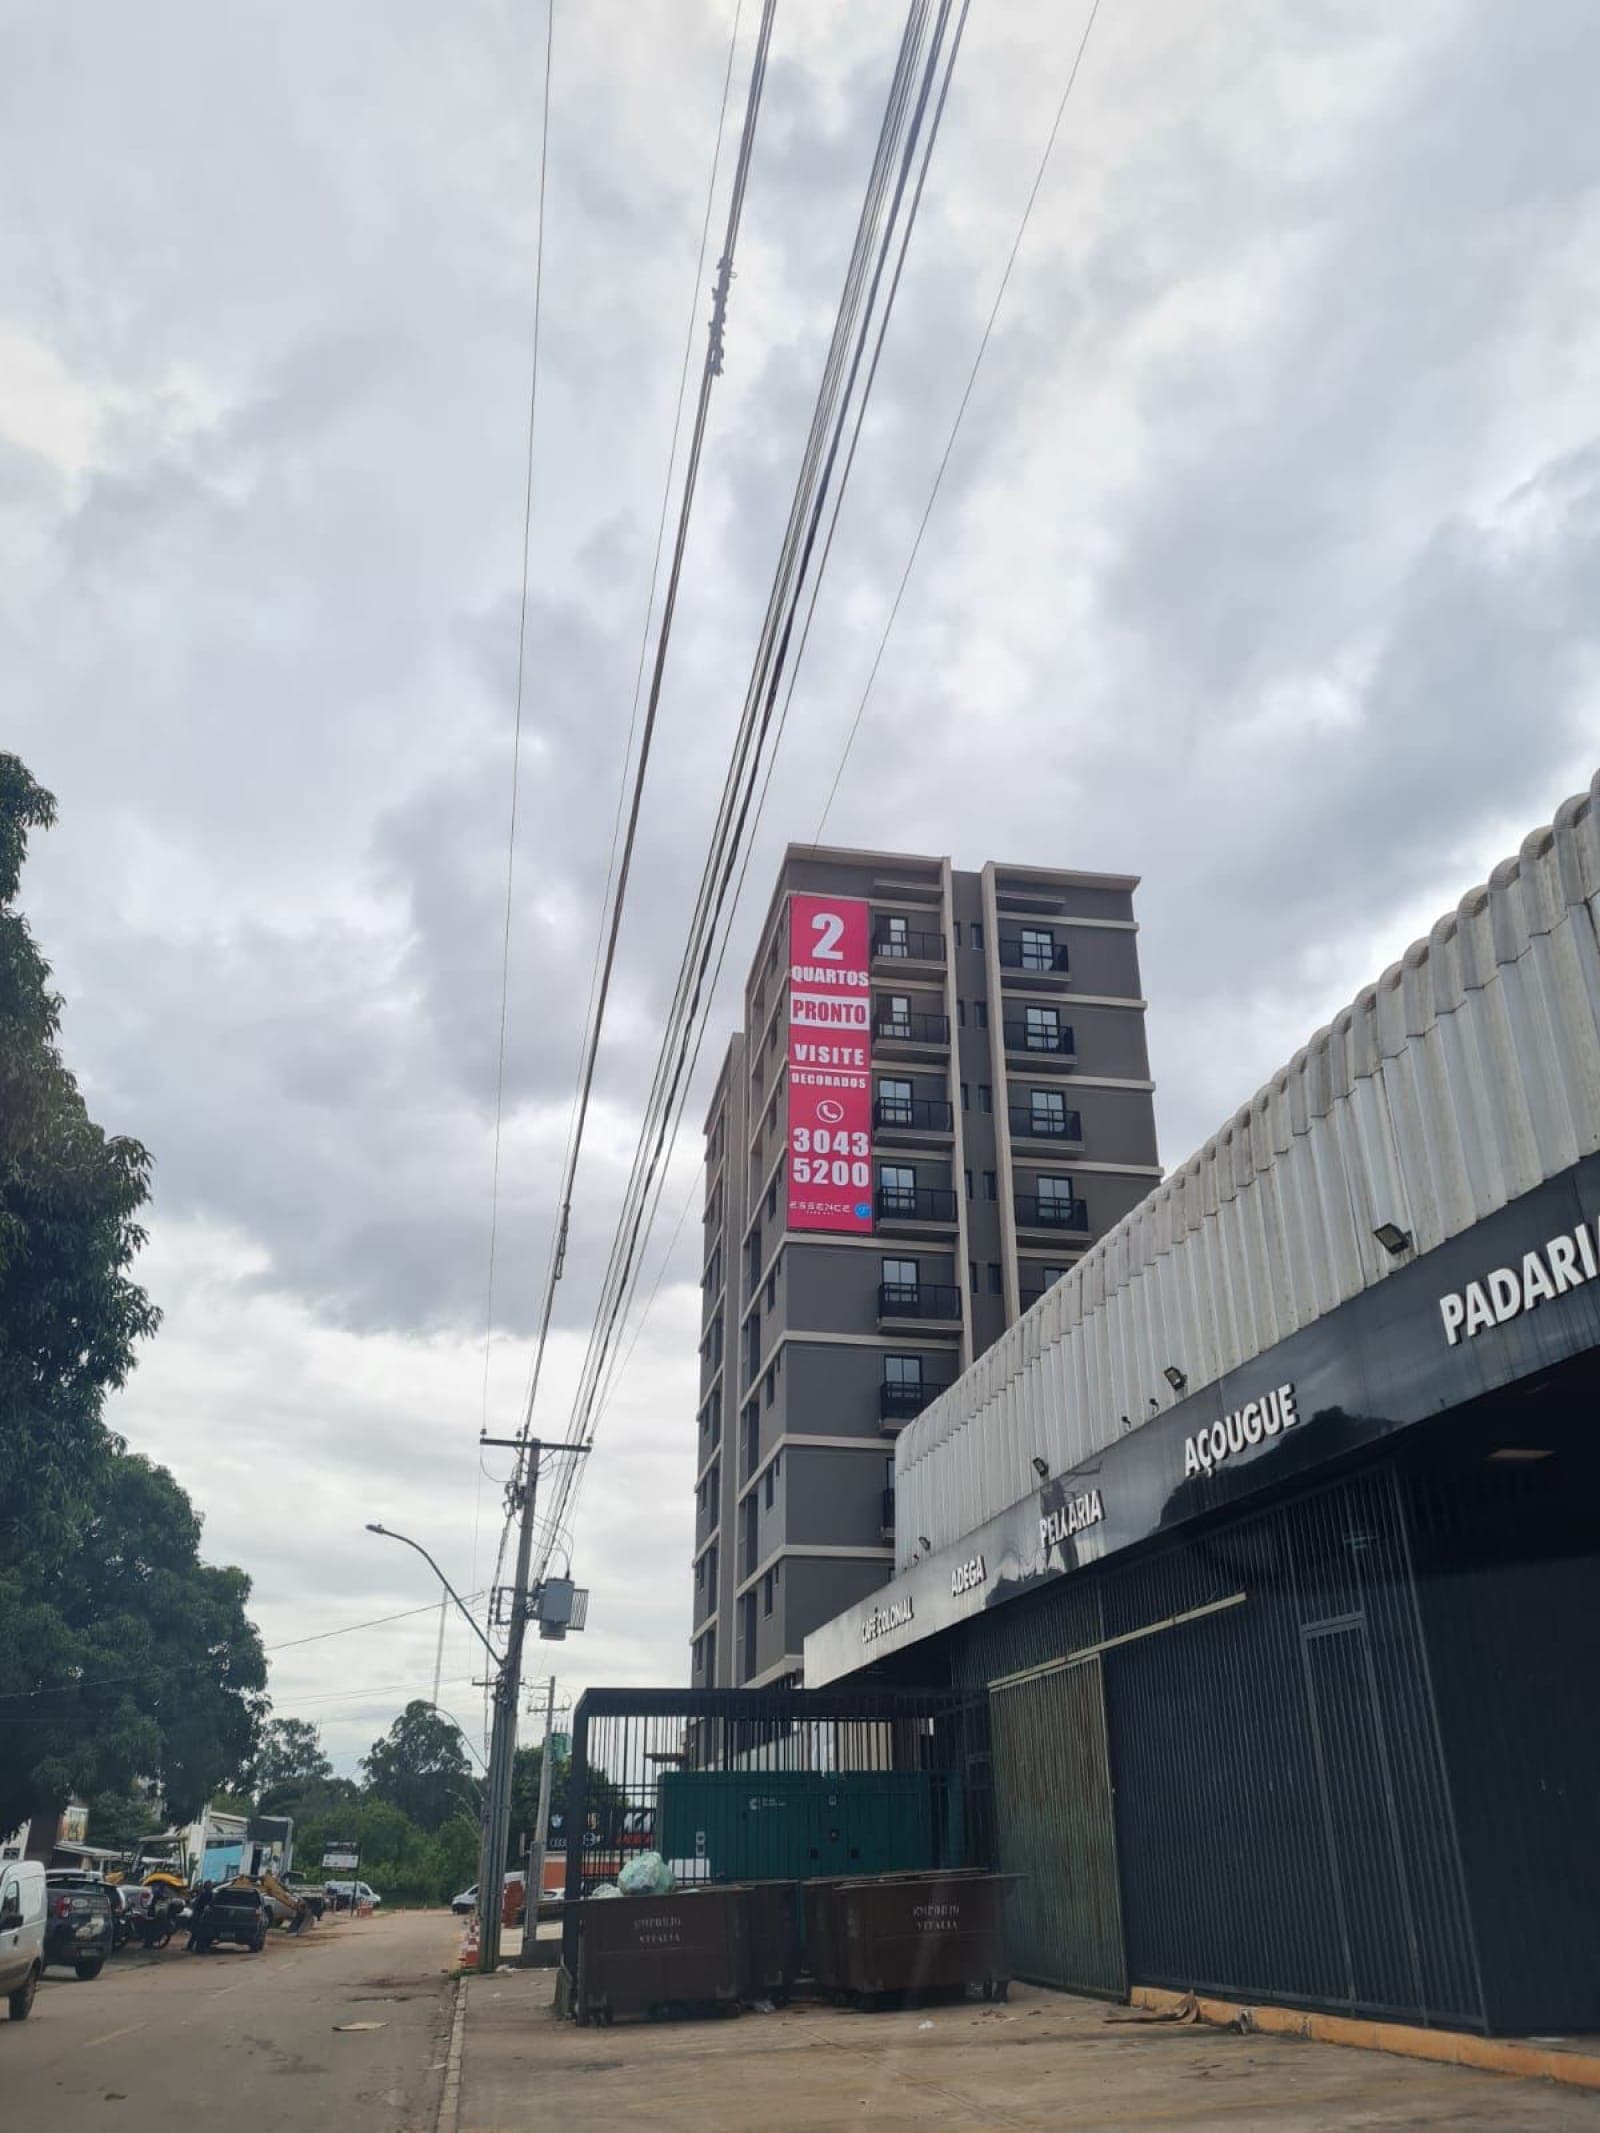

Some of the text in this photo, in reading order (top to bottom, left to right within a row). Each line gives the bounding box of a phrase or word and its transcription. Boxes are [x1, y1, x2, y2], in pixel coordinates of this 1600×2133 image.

[811, 912, 844, 961] 2
[791, 964, 869, 987] QUARTOS
[792, 1000, 866, 1025] PRONTO
[794, 1043, 865, 1066] VISITE
[791, 1072, 866, 1089] DECORADOS
[793, 1127, 869, 1157] 3043
[793, 1157, 869, 1188] 5200
[789, 1200, 851, 1213] ESSENCE
[1439, 1215, 1600, 1345] PADARI
[1184, 1383, 1298, 1477] AÇOUGUE
[951, 1555, 986, 1596] ADEGA
